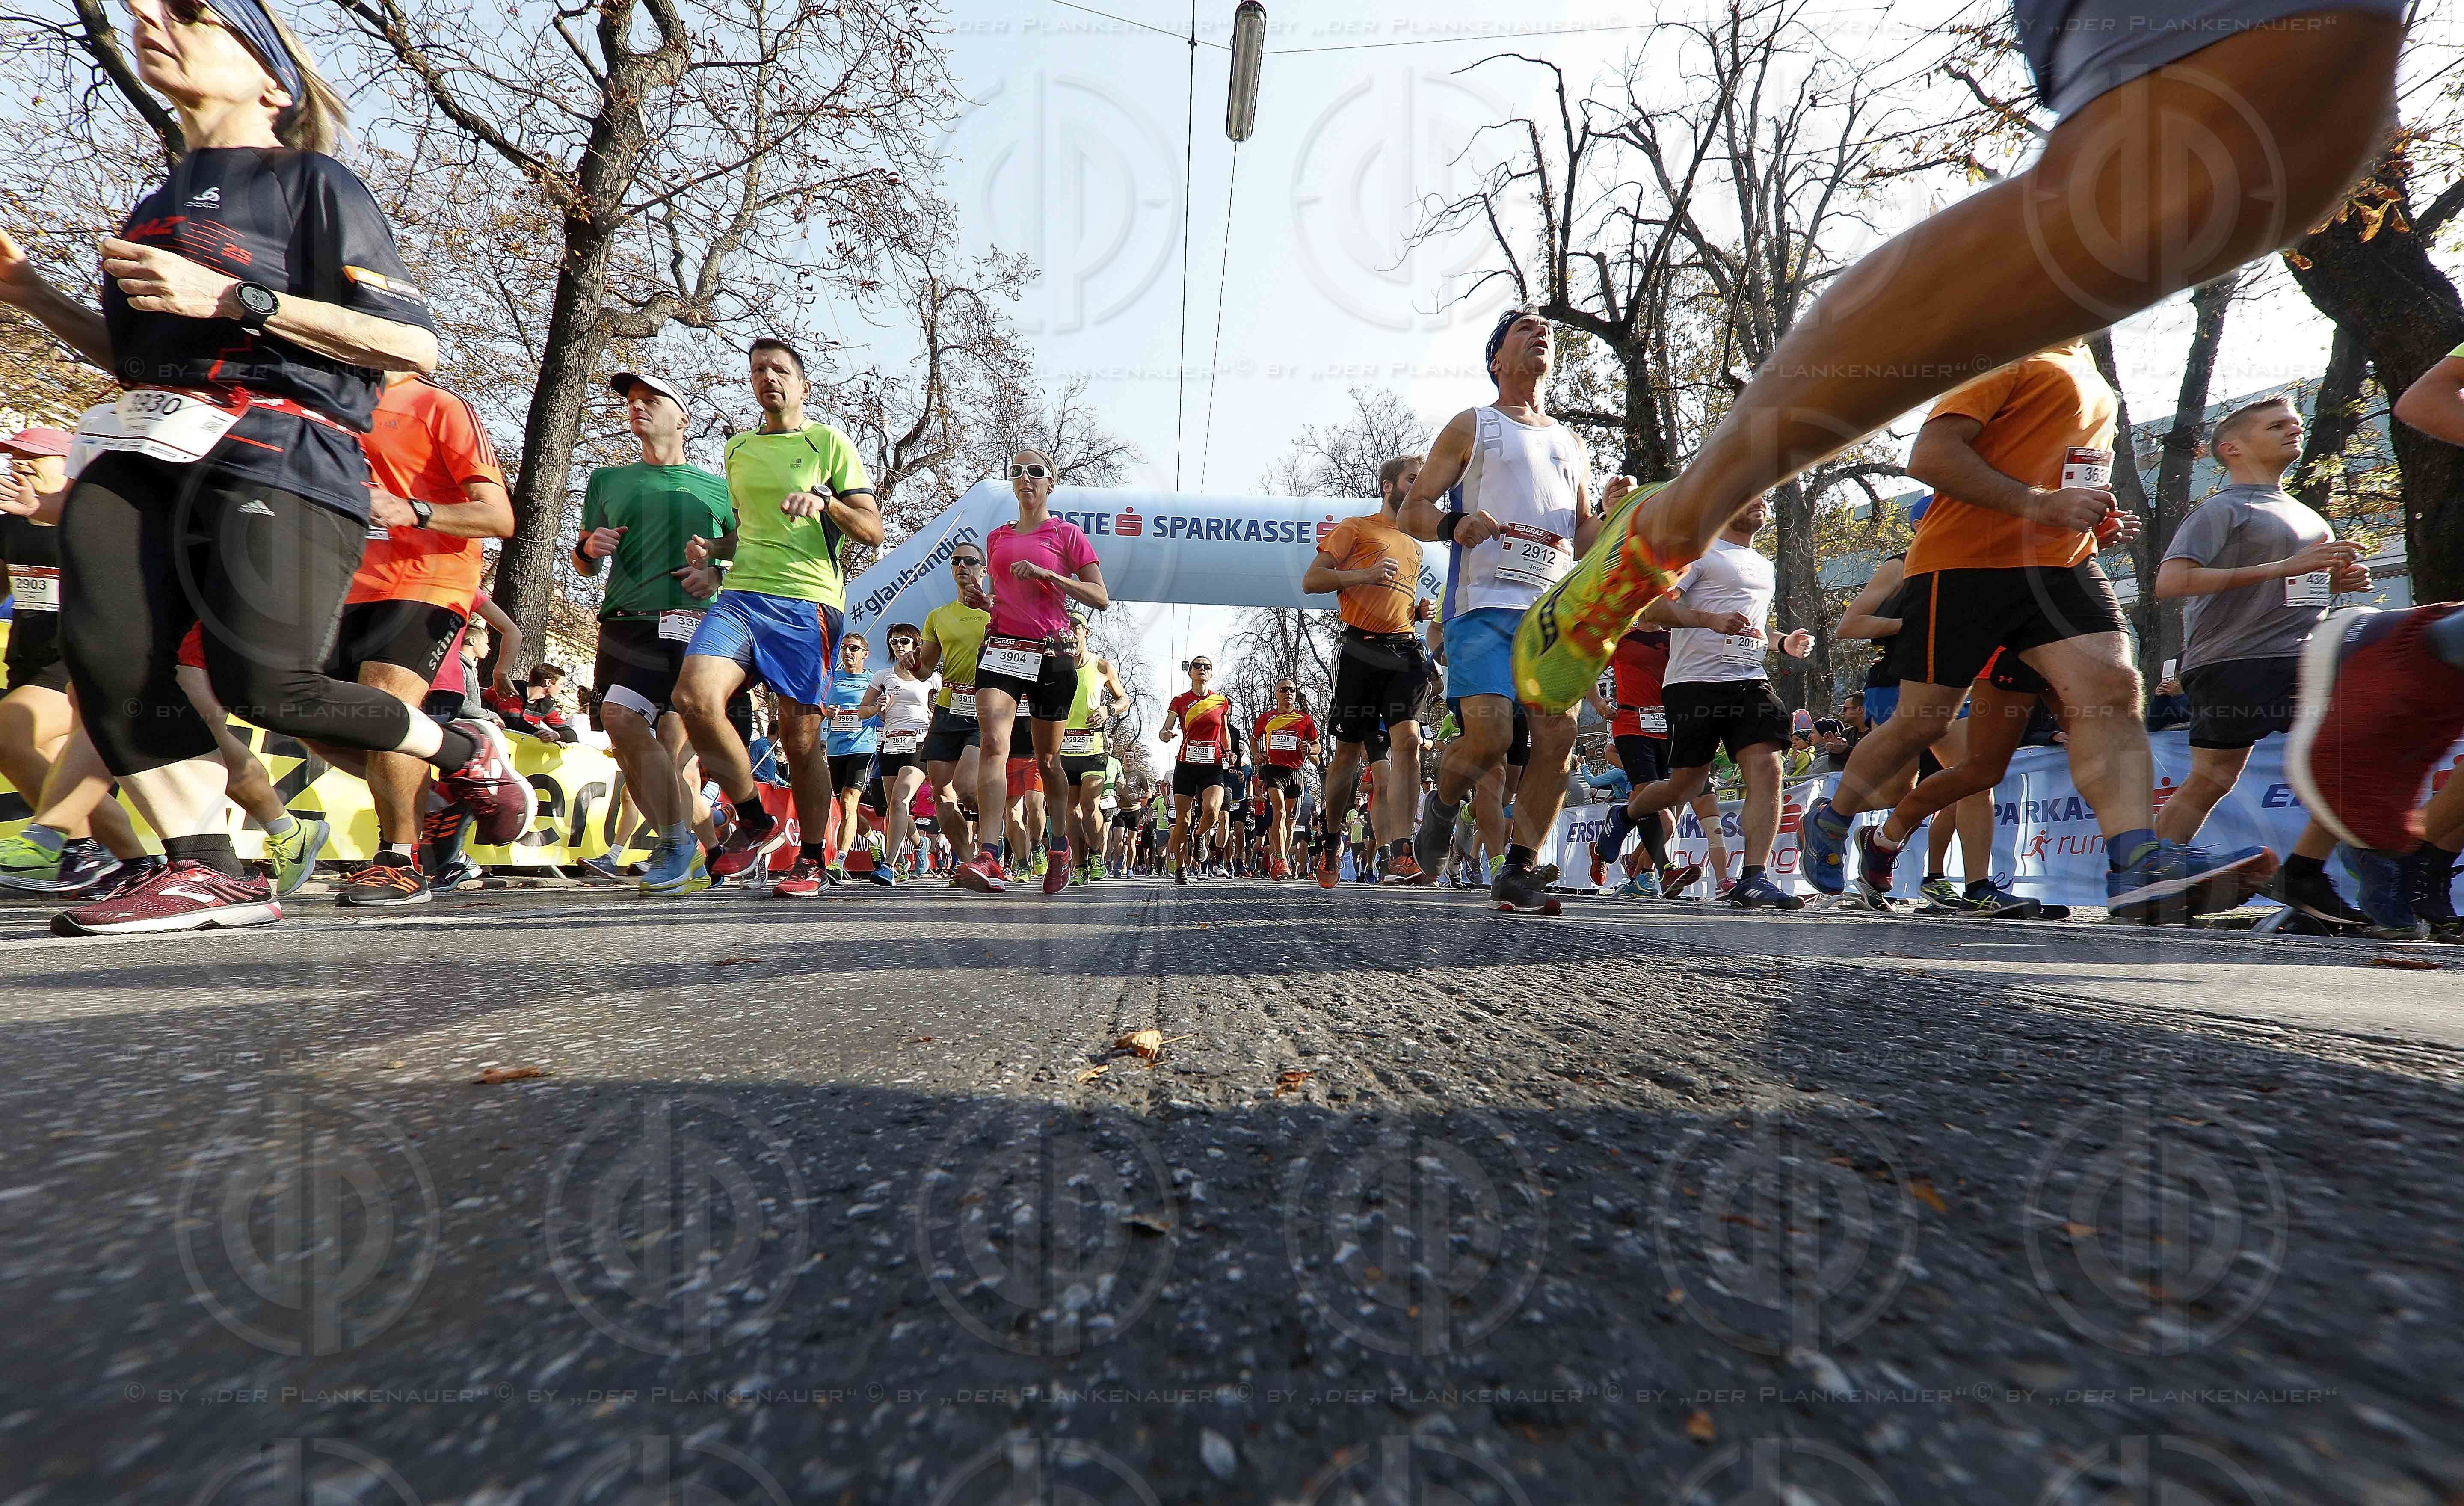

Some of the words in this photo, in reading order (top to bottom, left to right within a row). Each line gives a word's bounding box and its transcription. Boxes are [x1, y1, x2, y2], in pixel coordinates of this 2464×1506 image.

[1152, 515, 1312, 543] SPARKASSE
[1525, 527, 1544, 537] GRAZ
[1521, 543, 1556, 565] 2912
[1528, 564, 1545, 573] Josef
[850, 526, 979, 625] #glaubandich
[15, 578, 46, 590] 2903
[1738, 637, 1759, 649] 2011
[1000, 651, 1027, 664] 3904
[1566, 820, 1602, 842] ERST
